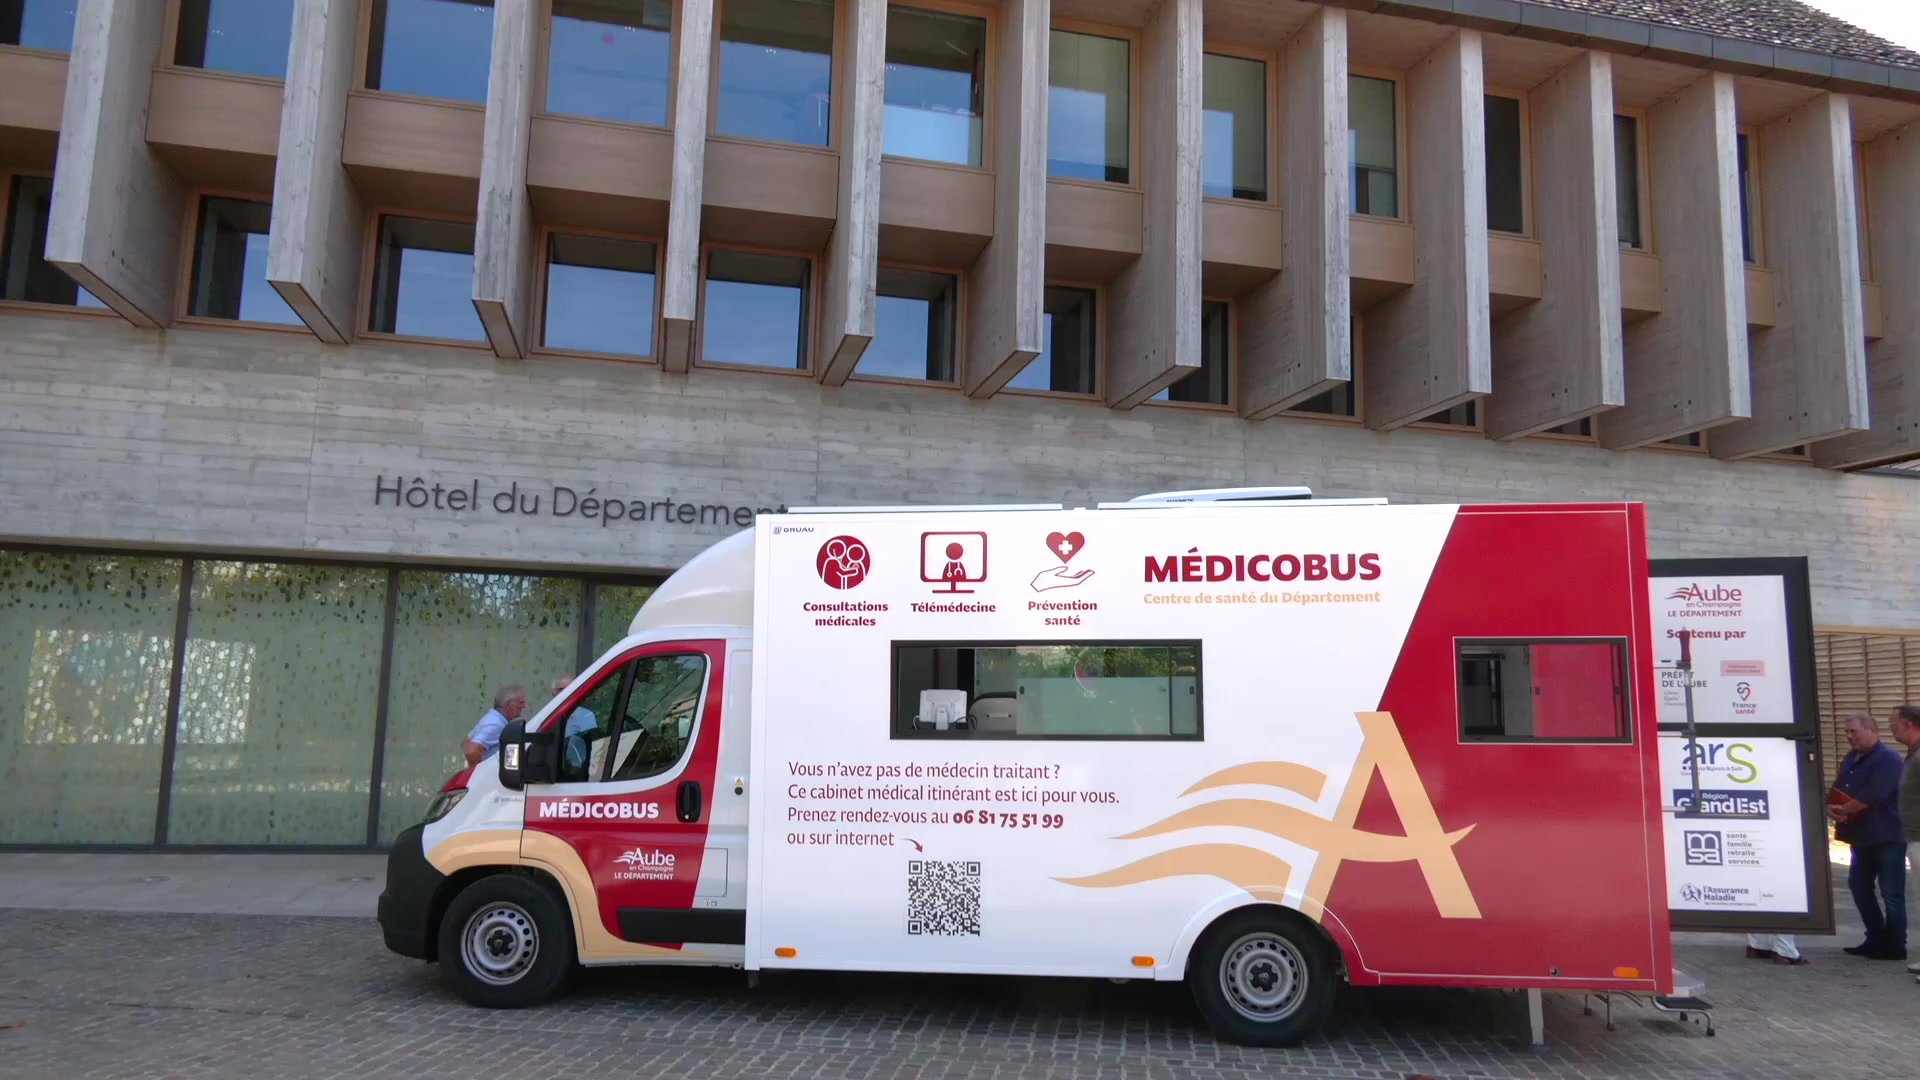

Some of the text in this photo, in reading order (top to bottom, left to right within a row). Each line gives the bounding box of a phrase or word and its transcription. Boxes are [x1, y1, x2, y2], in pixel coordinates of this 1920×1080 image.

[374, 474, 478, 512] Hôtel
[493, 480, 539, 515] du
[1143, 547, 1381, 584] MÉDICOBUS
[1143, 590, 1381, 606] Centre de santé du Département
[1686, 583, 1742, 602] Aube
[803, 600, 889, 613] Consultations
[910, 601, 996, 613] Télémédecine
[1027, 599, 1098, 611] Prévention
[1696, 601, 1742, 609] Champagne
[1044, 613, 1081, 626] santé
[1679, 609, 1742, 617] DÉPARTEMENT
[814, 614, 877, 627] médicales
[1666, 629, 1746, 641] Sotenu par
[1661, 670, 1695, 679] PRÉFT
[1662, 680, 1708, 688] DE L'UBE
[788, 761, 824, 777] Vous
[876, 765, 901, 780] pas
[905, 762, 923, 778] de
[926, 762, 989, 779] médecin
[993, 762, 1050, 780] traitant
[1053, 764, 1061, 780] ?
[788, 784, 1120, 807] Ce cabinet médical itinérant est ici pour vous.
[539, 798, 659, 819] MÉDICOBUS
[788, 807, 837, 823] Prenez
[840, 807, 928, 824] rendez-vous
[931, 811, 949, 825] au
[978, 809, 996, 825] 81
[999, 813, 1018, 829] 75
[1021, 813, 1038, 829] 51
[1041, 813, 1064, 829] 99
[787, 830, 895, 847] ou sur internet
[631, 848, 675, 866] Aube
[1727, 849, 1756, 857] retraite
[624, 871, 673, 880] DÉPARTEMENT
[638, 865, 674, 873] Champagne
[1703, 894, 1736, 902] Maladie
